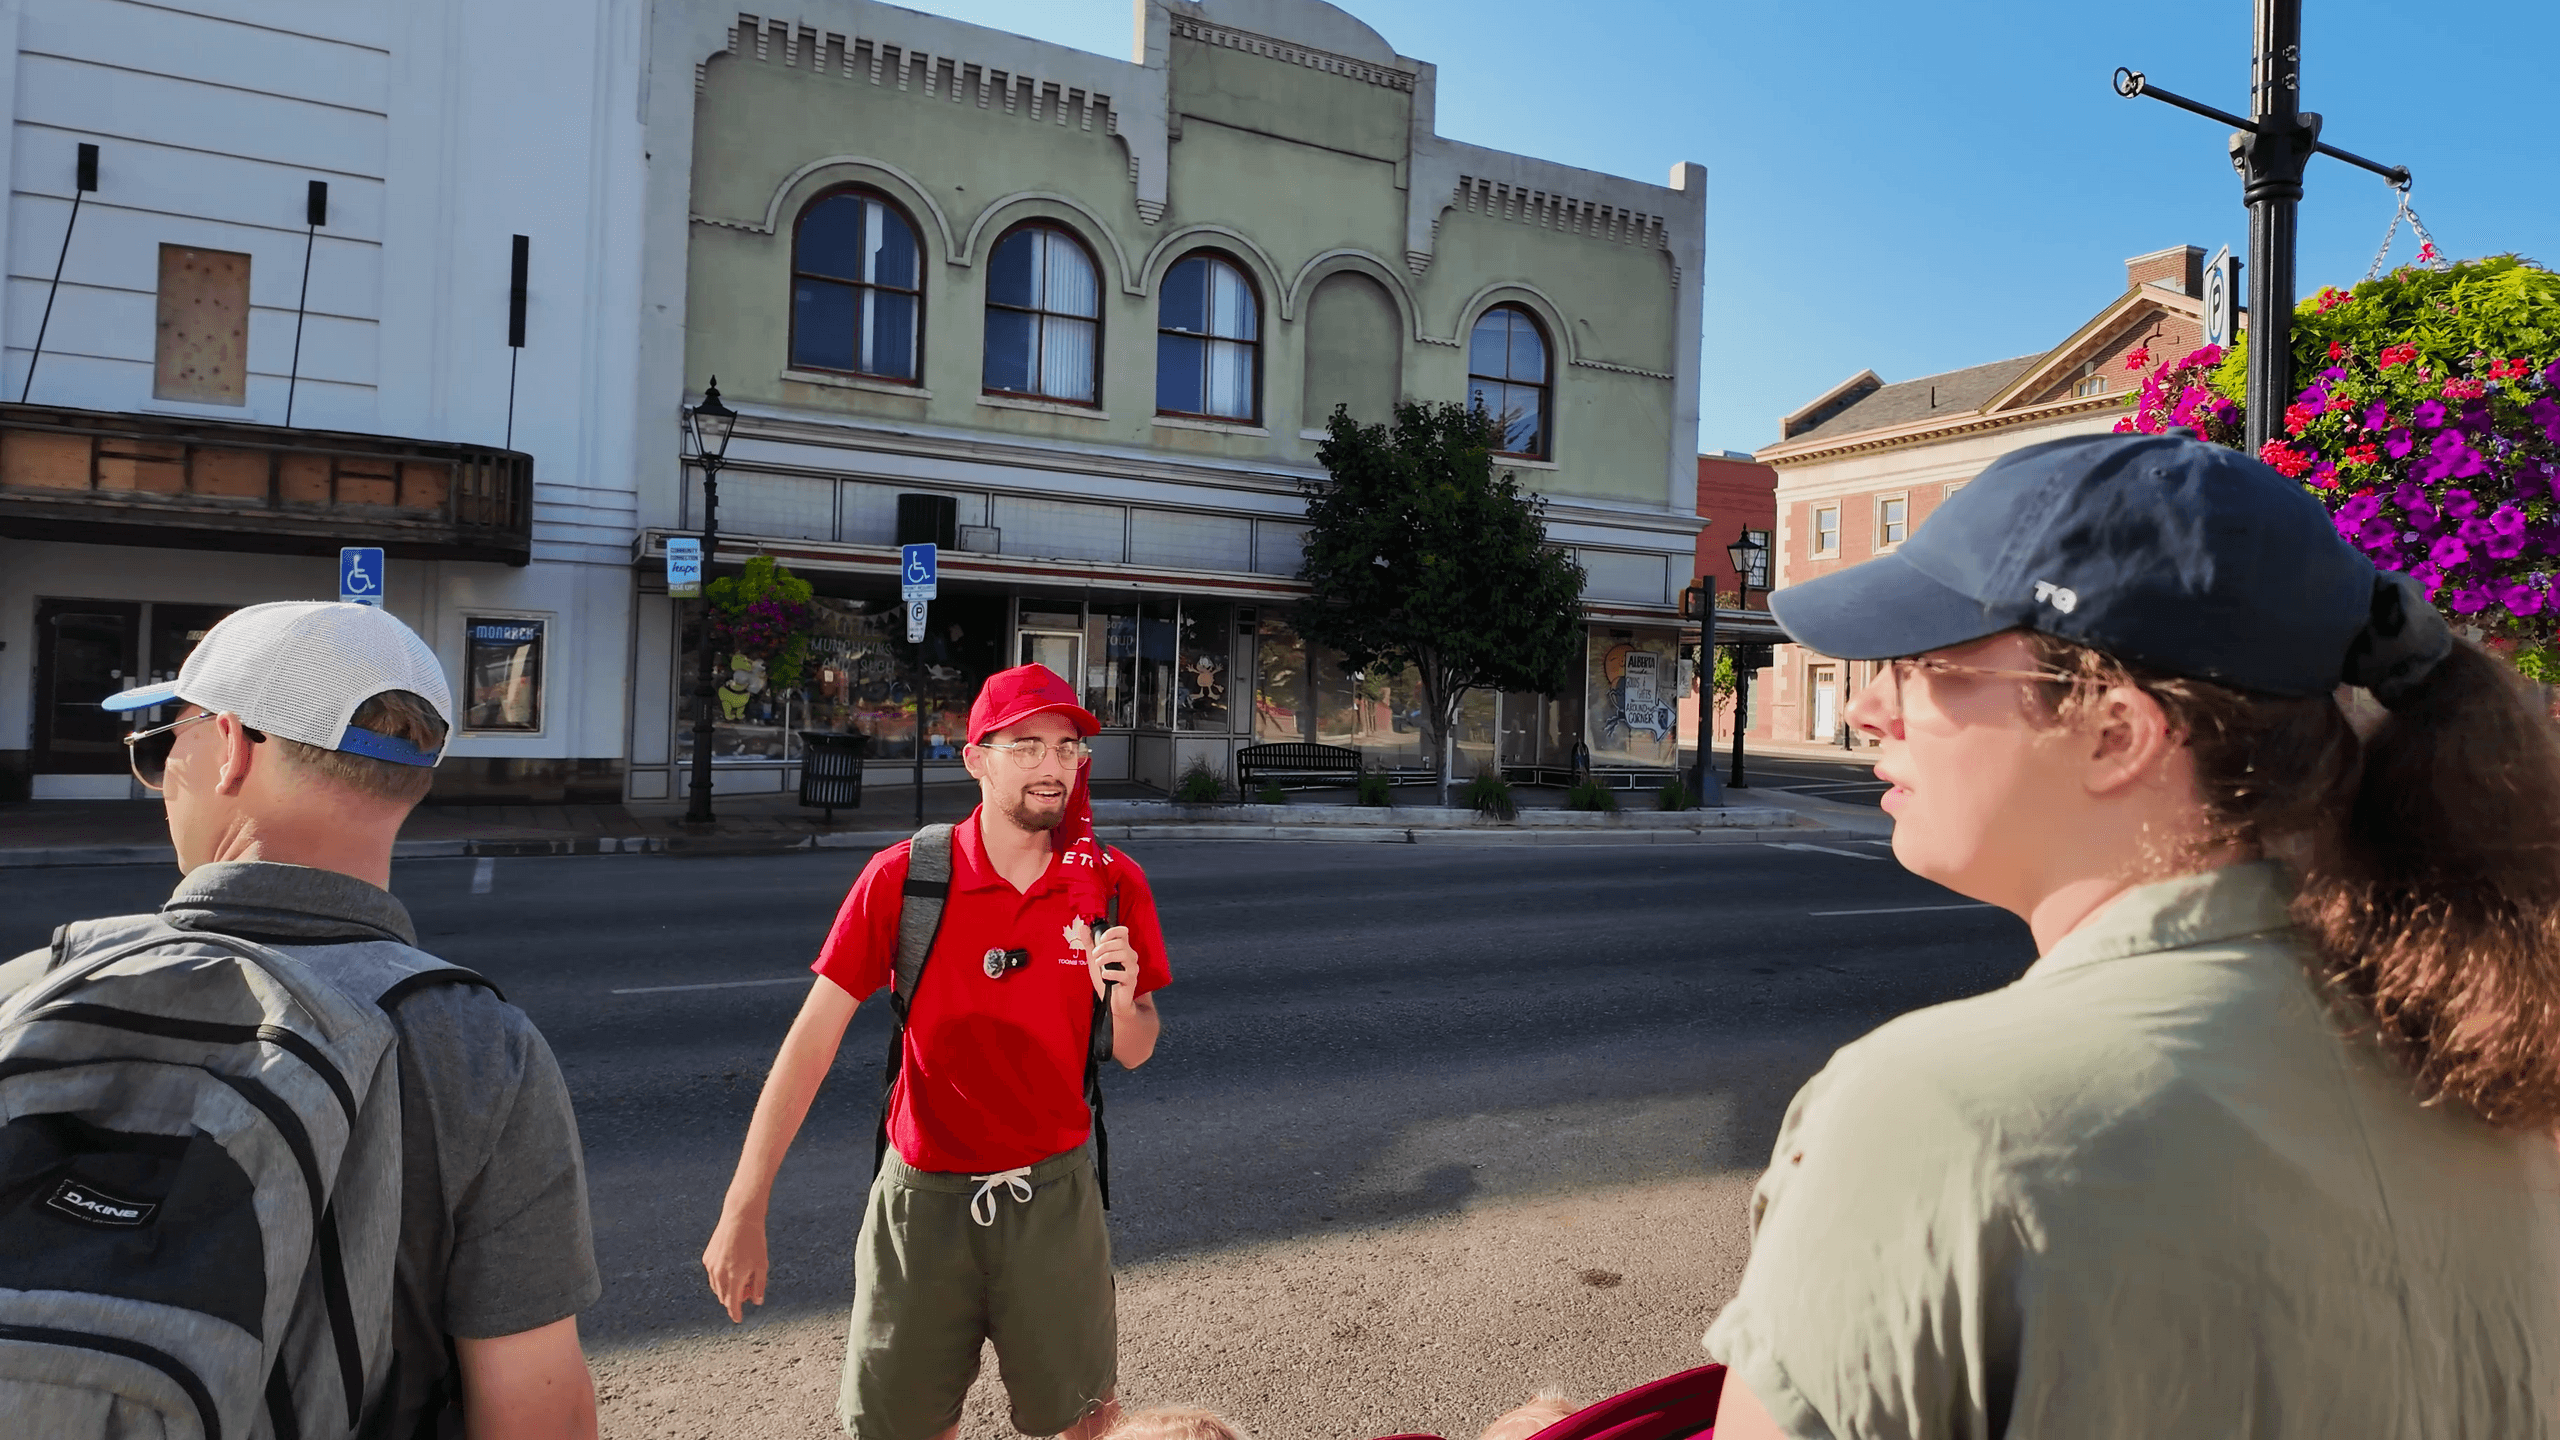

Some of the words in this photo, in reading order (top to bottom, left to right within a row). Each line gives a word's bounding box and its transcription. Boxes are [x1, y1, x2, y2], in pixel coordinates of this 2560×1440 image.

[2213, 284, 2221, 331] P
[672, 561, 698, 576] hope
[915, 607, 923, 618] P
[476, 625, 534, 640] MONARCH
[810, 637, 894, 658] MUNCHKINS
[1627, 655, 1655, 669] ALBERTA
[1628, 712, 1655, 724] CORNER
[63, 1191, 139, 1218] DAKINE
